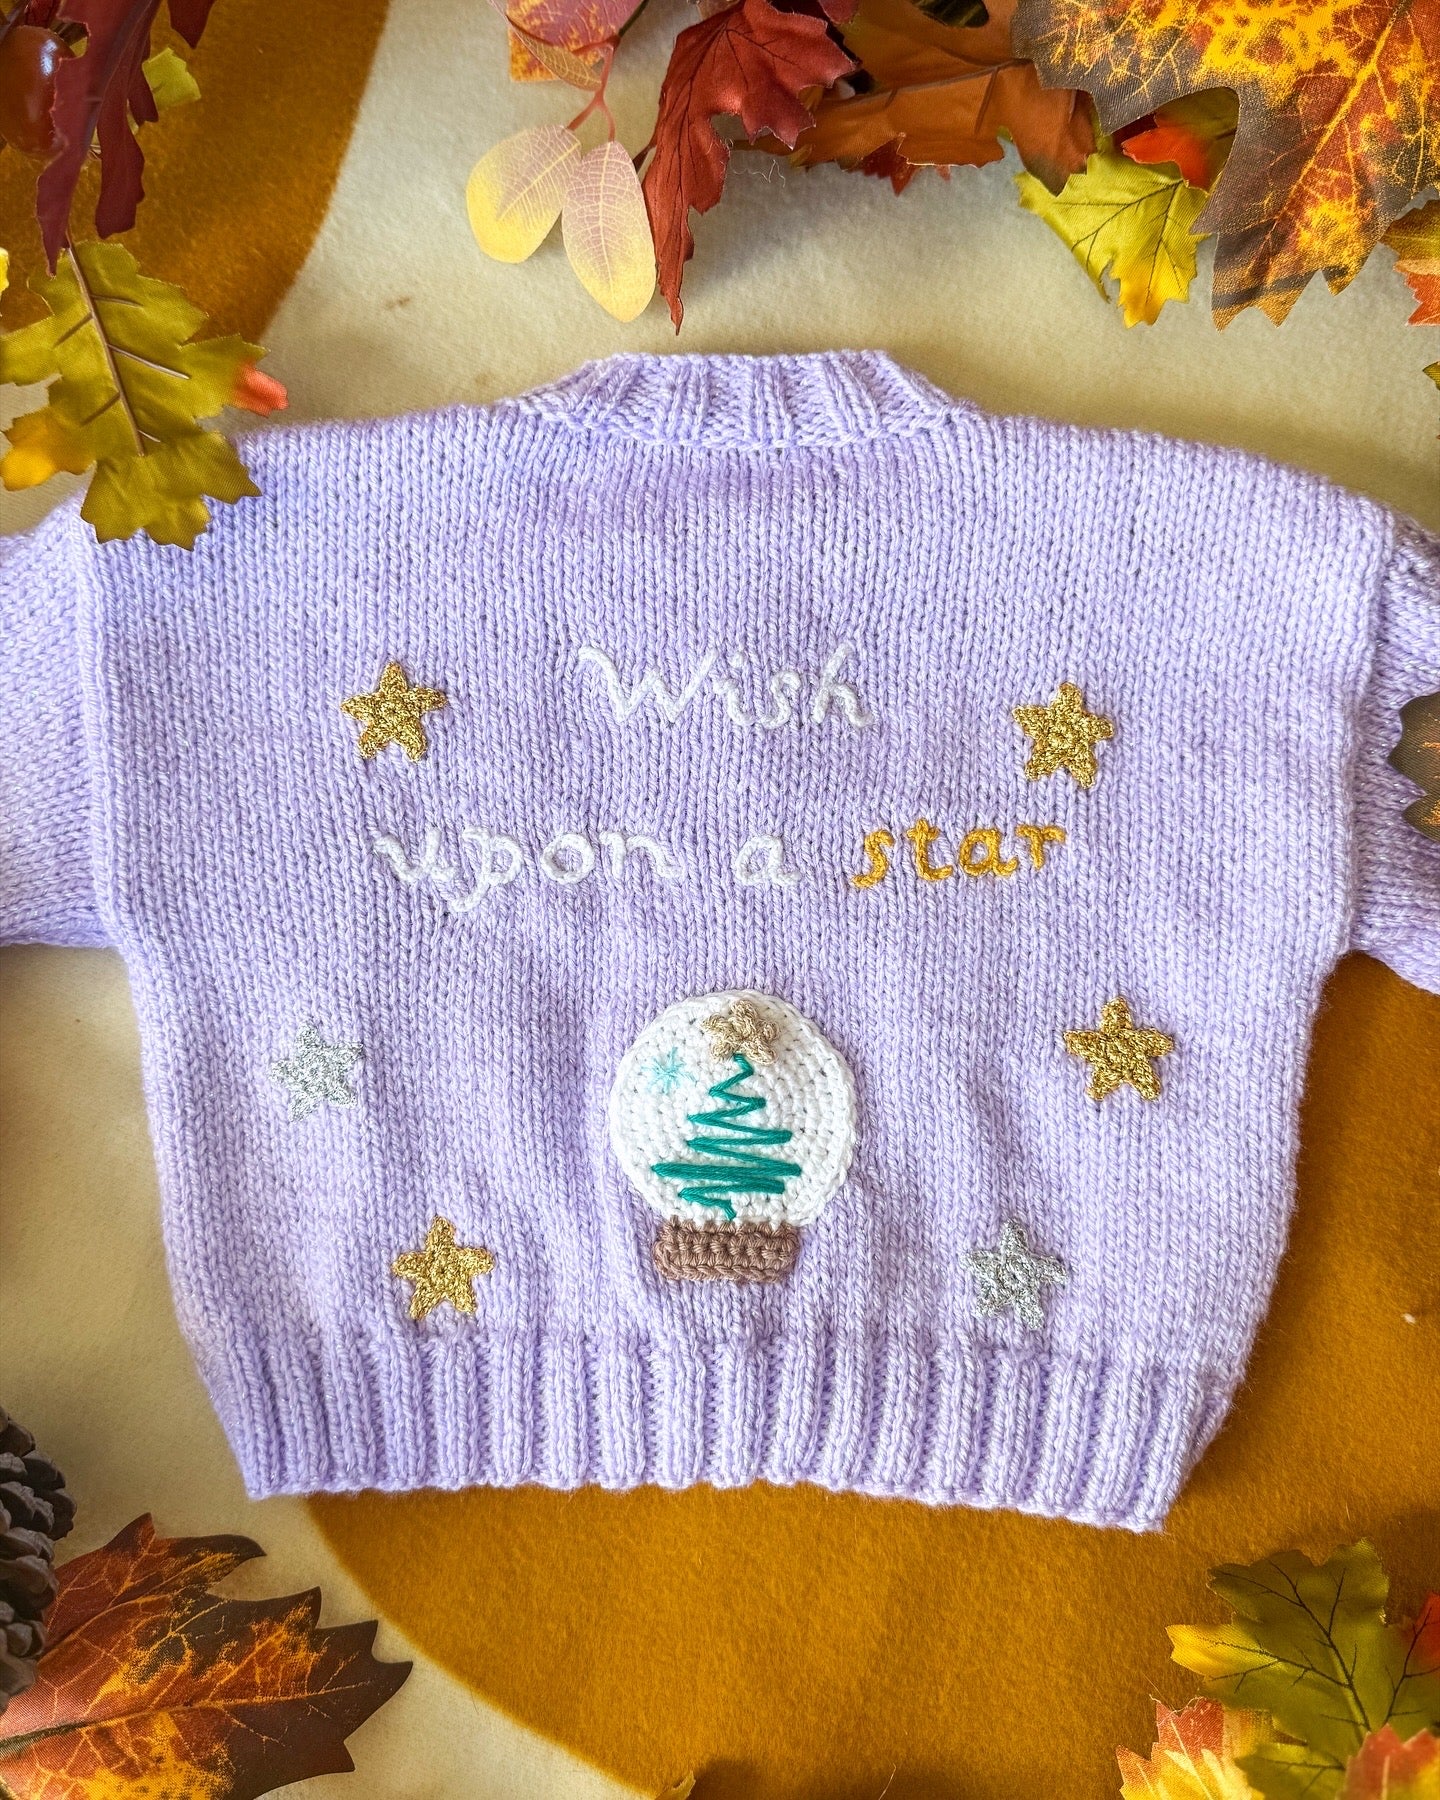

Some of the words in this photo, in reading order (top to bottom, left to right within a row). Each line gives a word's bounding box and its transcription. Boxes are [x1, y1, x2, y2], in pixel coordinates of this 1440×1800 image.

[578, 641, 877, 730] Wish
[372, 825, 686, 914] upon
[734, 833, 800, 886] a
[851, 817, 1067, 889] star
